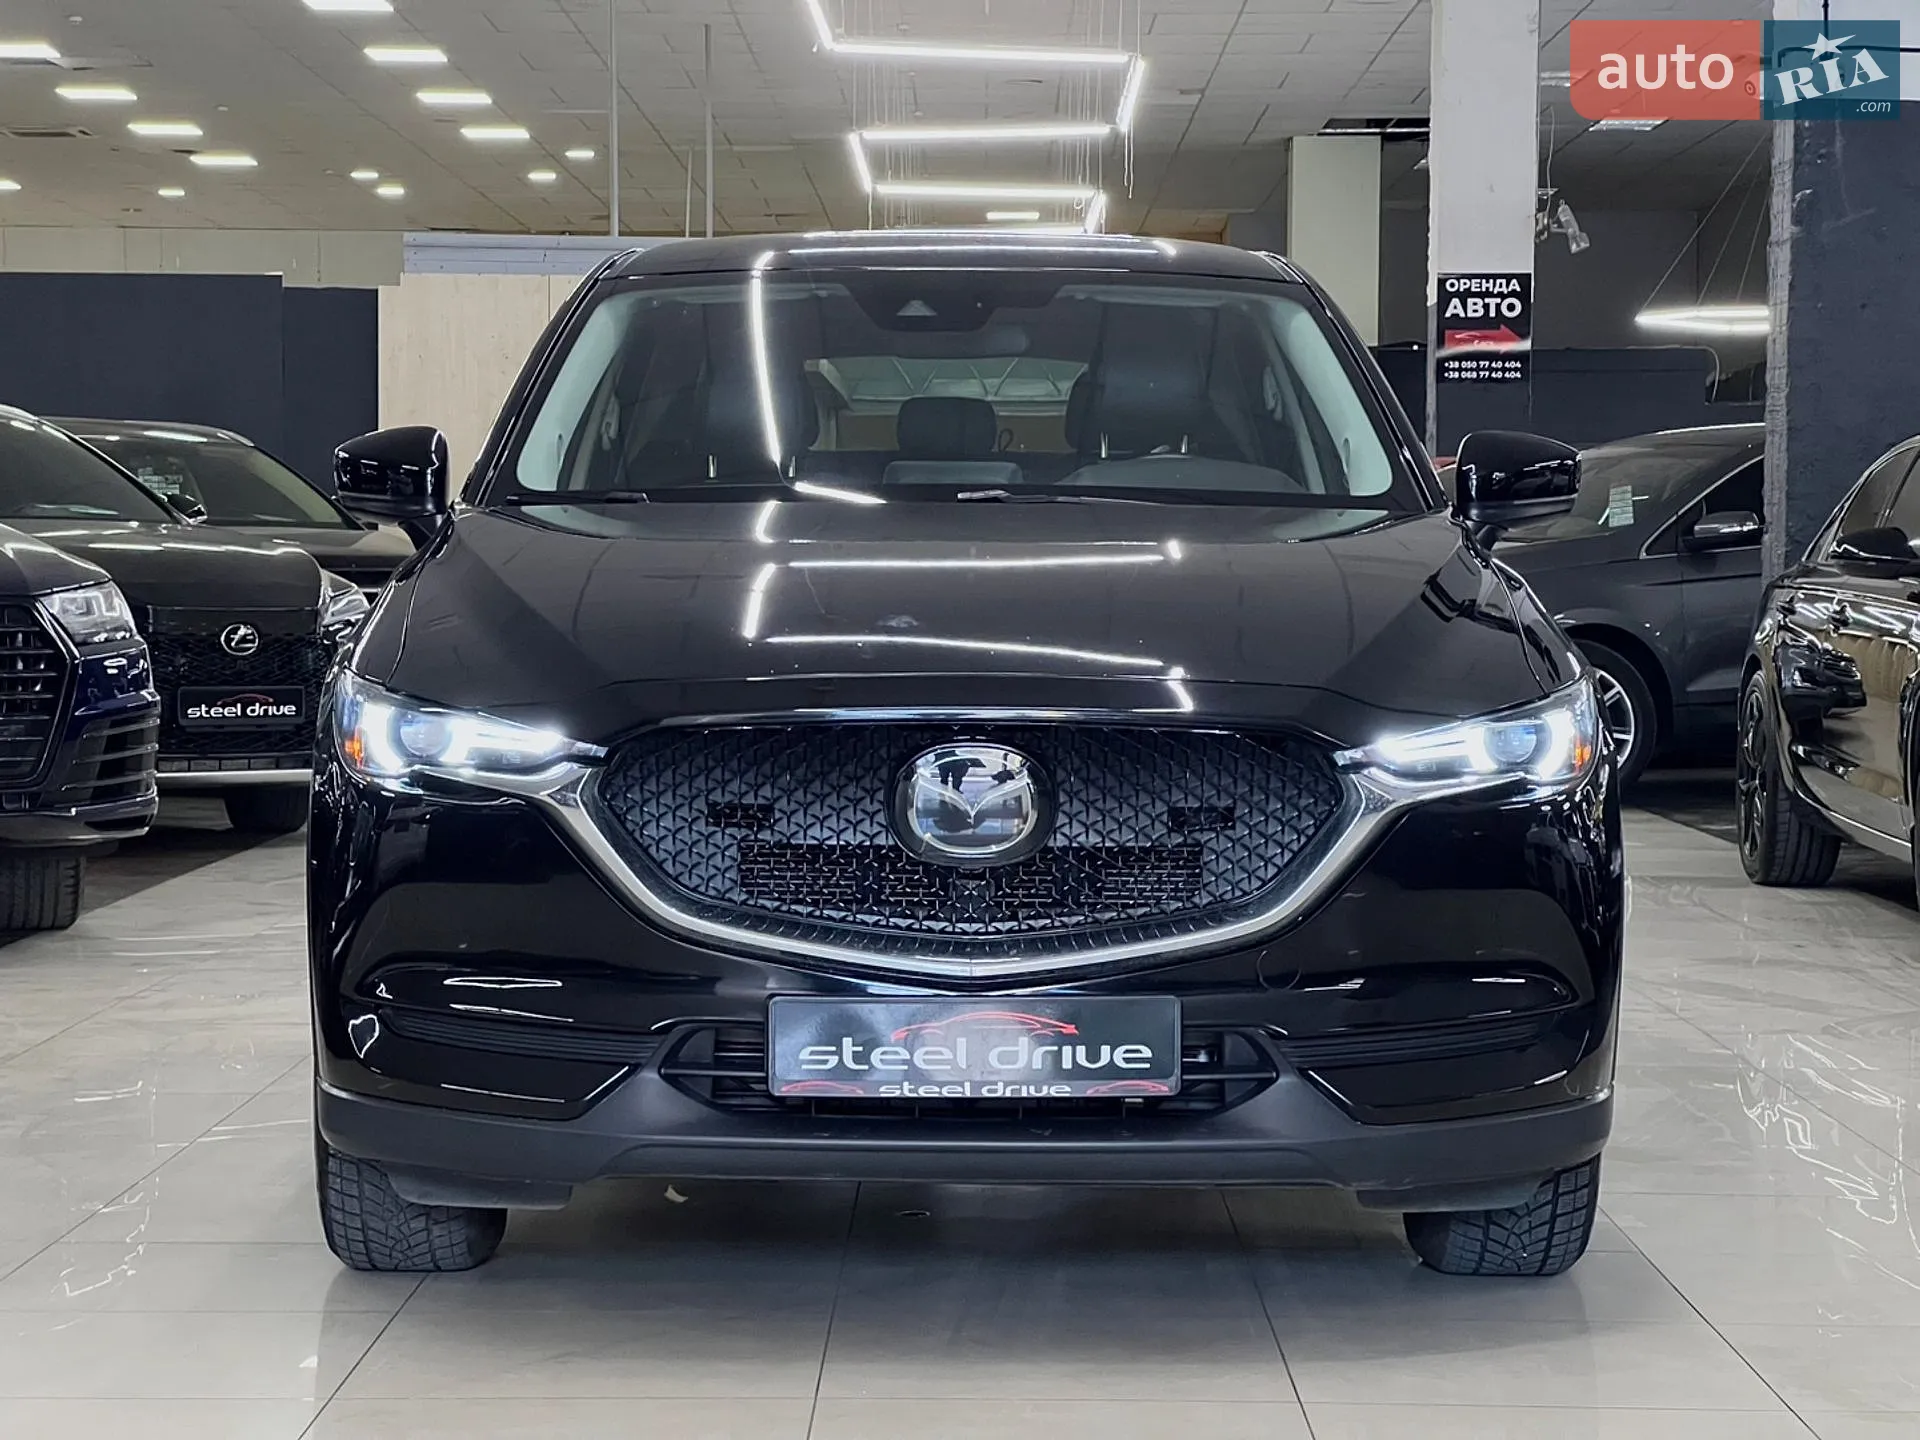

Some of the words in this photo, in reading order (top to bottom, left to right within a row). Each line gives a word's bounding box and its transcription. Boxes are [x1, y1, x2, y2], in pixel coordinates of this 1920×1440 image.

[1445, 279, 1521, 294] ОРЕНДА
[1444, 297, 1522, 318] АВТО
[187, 703, 241, 718] steel
[246, 703, 297, 716] drive
[800, 1037, 967, 1070] steel
[988, 1037, 1153, 1070] drive
[879, 1081, 971, 1097] steel
[981, 1082, 1072, 1097] drive
